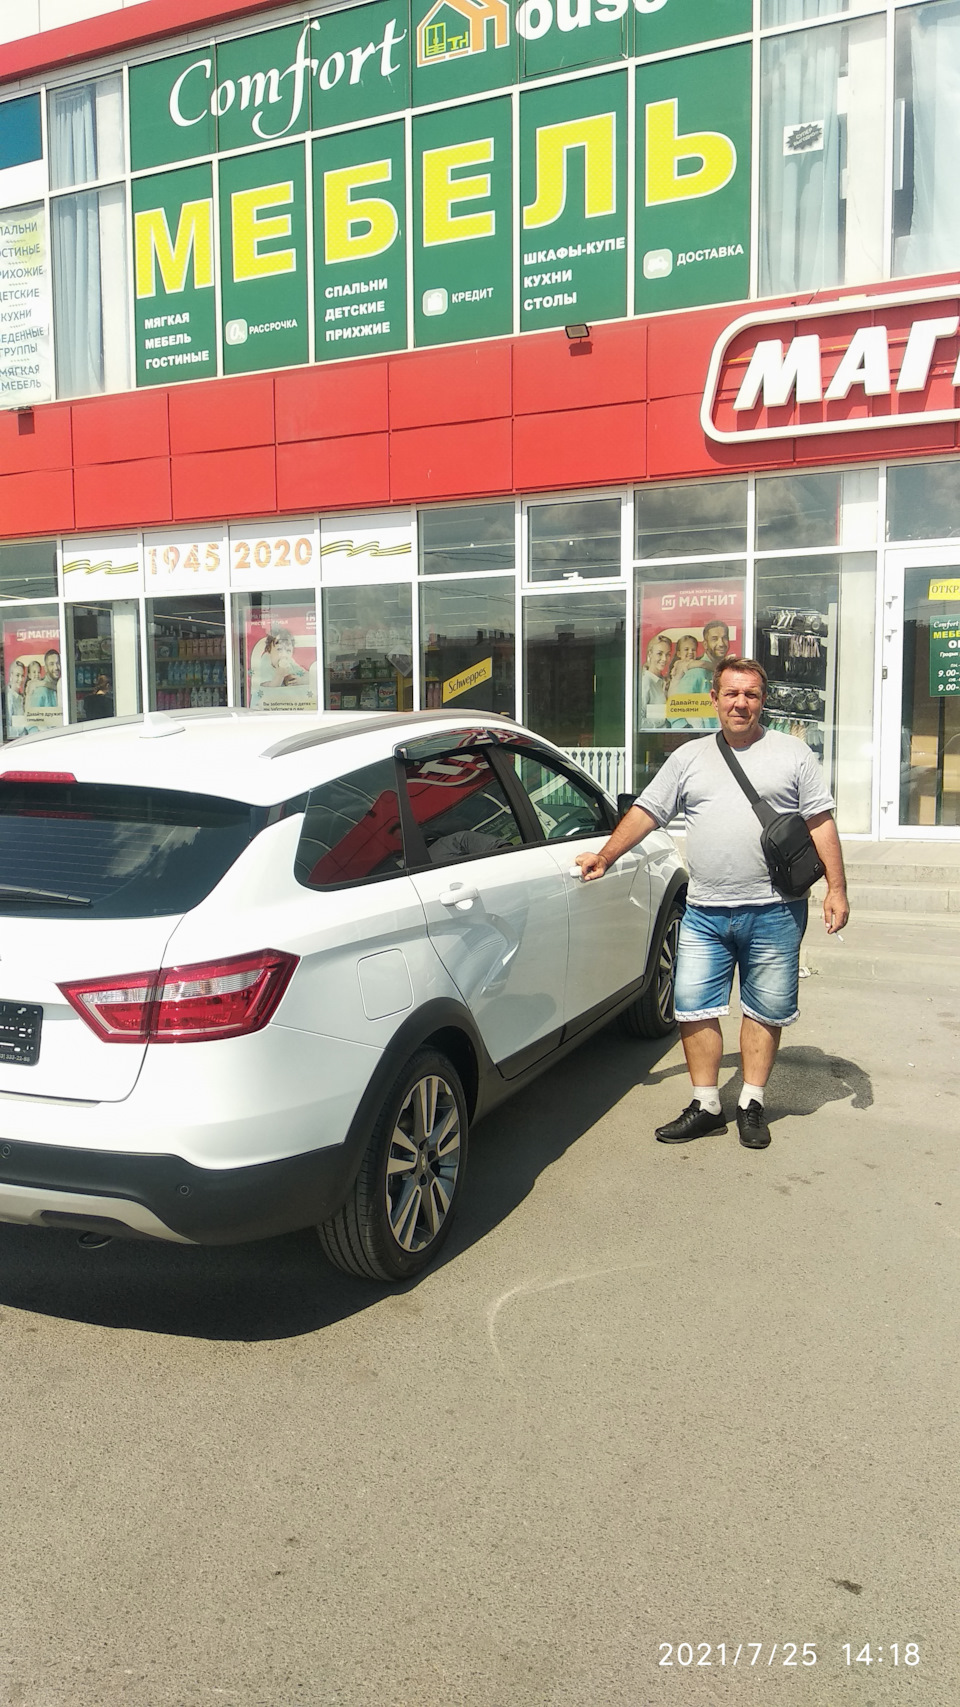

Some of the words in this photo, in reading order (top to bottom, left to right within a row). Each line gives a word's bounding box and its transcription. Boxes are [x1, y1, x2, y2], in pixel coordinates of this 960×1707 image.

[169, 18, 408, 140] Comfort
[134, 98, 738, 299] МЕБЕЛЬ
[0, 243, 41, 258] СТИНЫЕ
[523, 236, 626, 266] ШКАФЫ-КУПЕ
[676, 244, 744, 266] ДОСТАВКА
[0, 265, 44, 279] ИХОЖИЕ
[523, 269, 573, 288] КУХНИ
[0, 288, 40, 303] ЕТСКИЕ
[324, 278, 388, 298] СПАЛЬНИ
[451, 287, 494, 304] КРЕДИТ
[523, 292, 577, 311] СТОЛЫ
[1, 309, 32, 322] КУХНИ
[324, 300, 386, 322] ДЕТСКИЕ
[144, 312, 190, 329] МЯГКАЯ
[249, 319, 298, 335] РАССРОЧКА
[145, 333, 192, 349] МЕБЕЛЬ
[325, 322, 391, 342] ПРИХЖИЕ
[145, 350, 210, 369] ГОСТИНЫЕ
[732, 316, 960, 411] МАГ
[1, 379, 42, 391] МЕБЕЛЬ
[148, 543, 221, 575] 1945
[234, 537, 313, 569] 2020
[931, 585, 960, 594] ОТКР
[679, 594, 737, 608] МАГНИТ
[28, 629, 60, 639] МАГНИ
[448, 667, 487, 693] Schweppes
[669, 698, 699, 706] Давайте
[699, 700, 713, 708] дру
